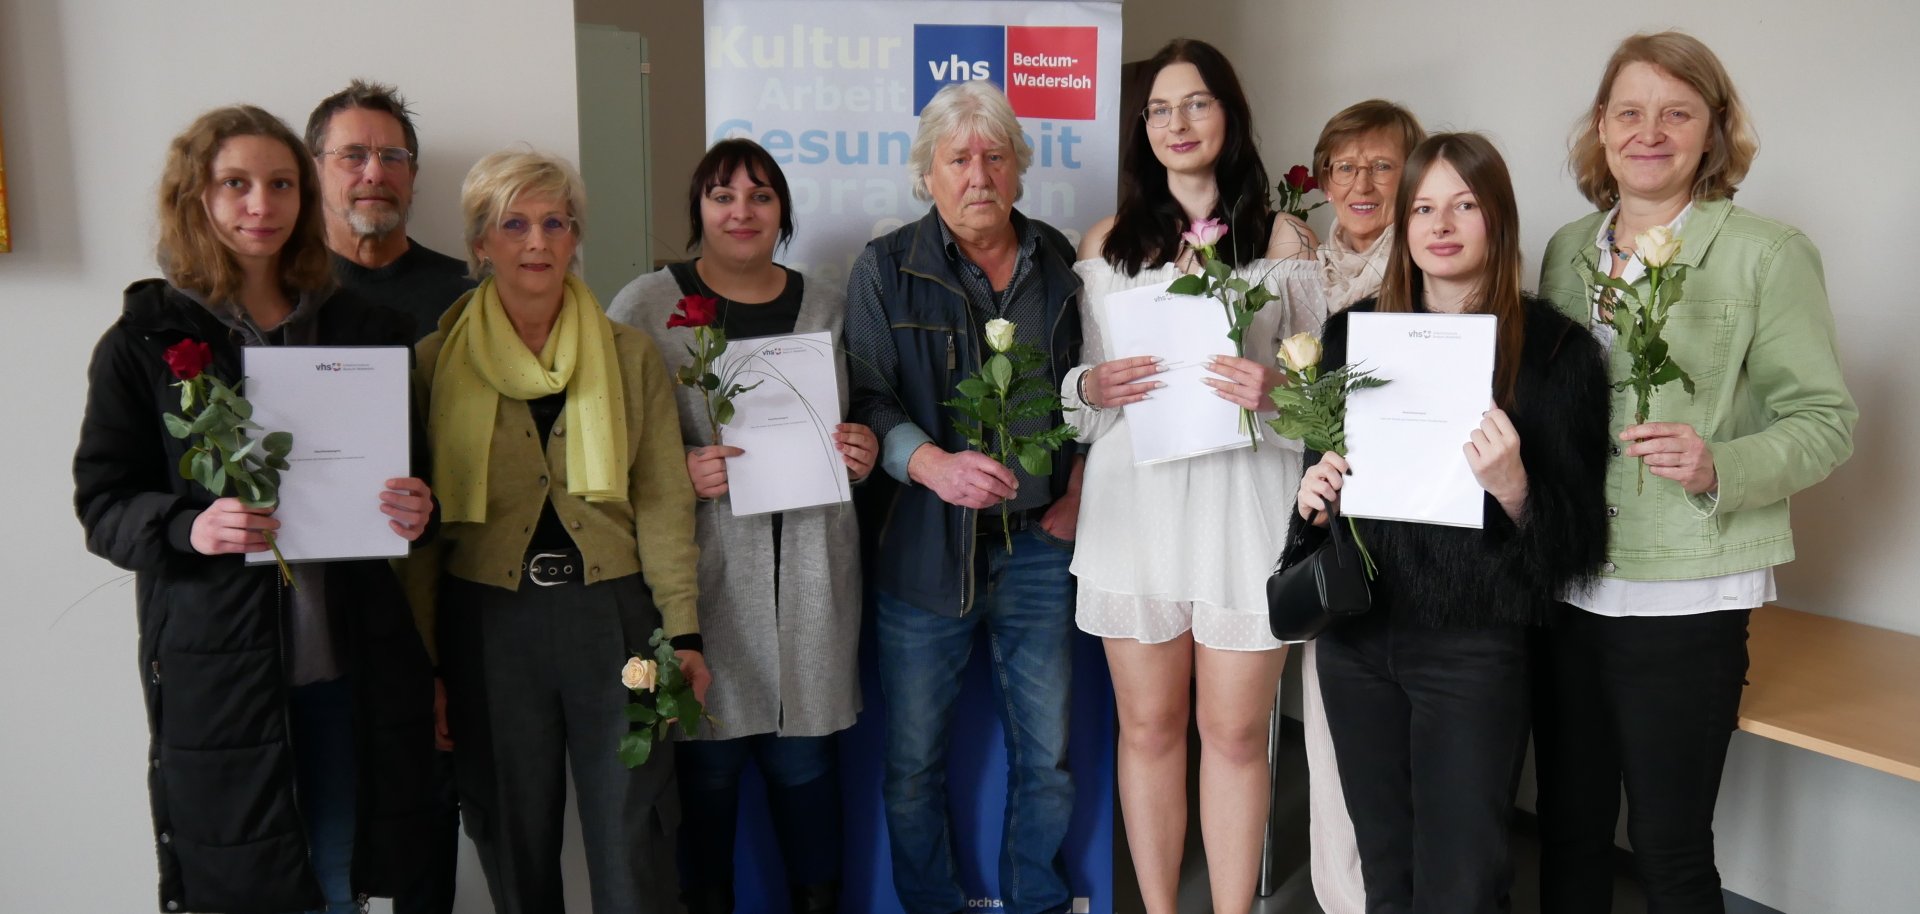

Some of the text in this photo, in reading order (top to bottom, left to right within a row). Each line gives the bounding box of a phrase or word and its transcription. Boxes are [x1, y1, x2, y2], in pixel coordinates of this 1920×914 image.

[710, 24, 903, 70] Kultur
[929, 54, 991, 82] vhs
[1012, 52, 1079, 69] Beckum-
[1012, 71, 1092, 90] Wadersloh
[756, 76, 907, 113] Arbeit
[1408, 330, 1423, 338] vhs
[762, 348, 775, 356] vhs
[315, 363, 332, 371] vhs
